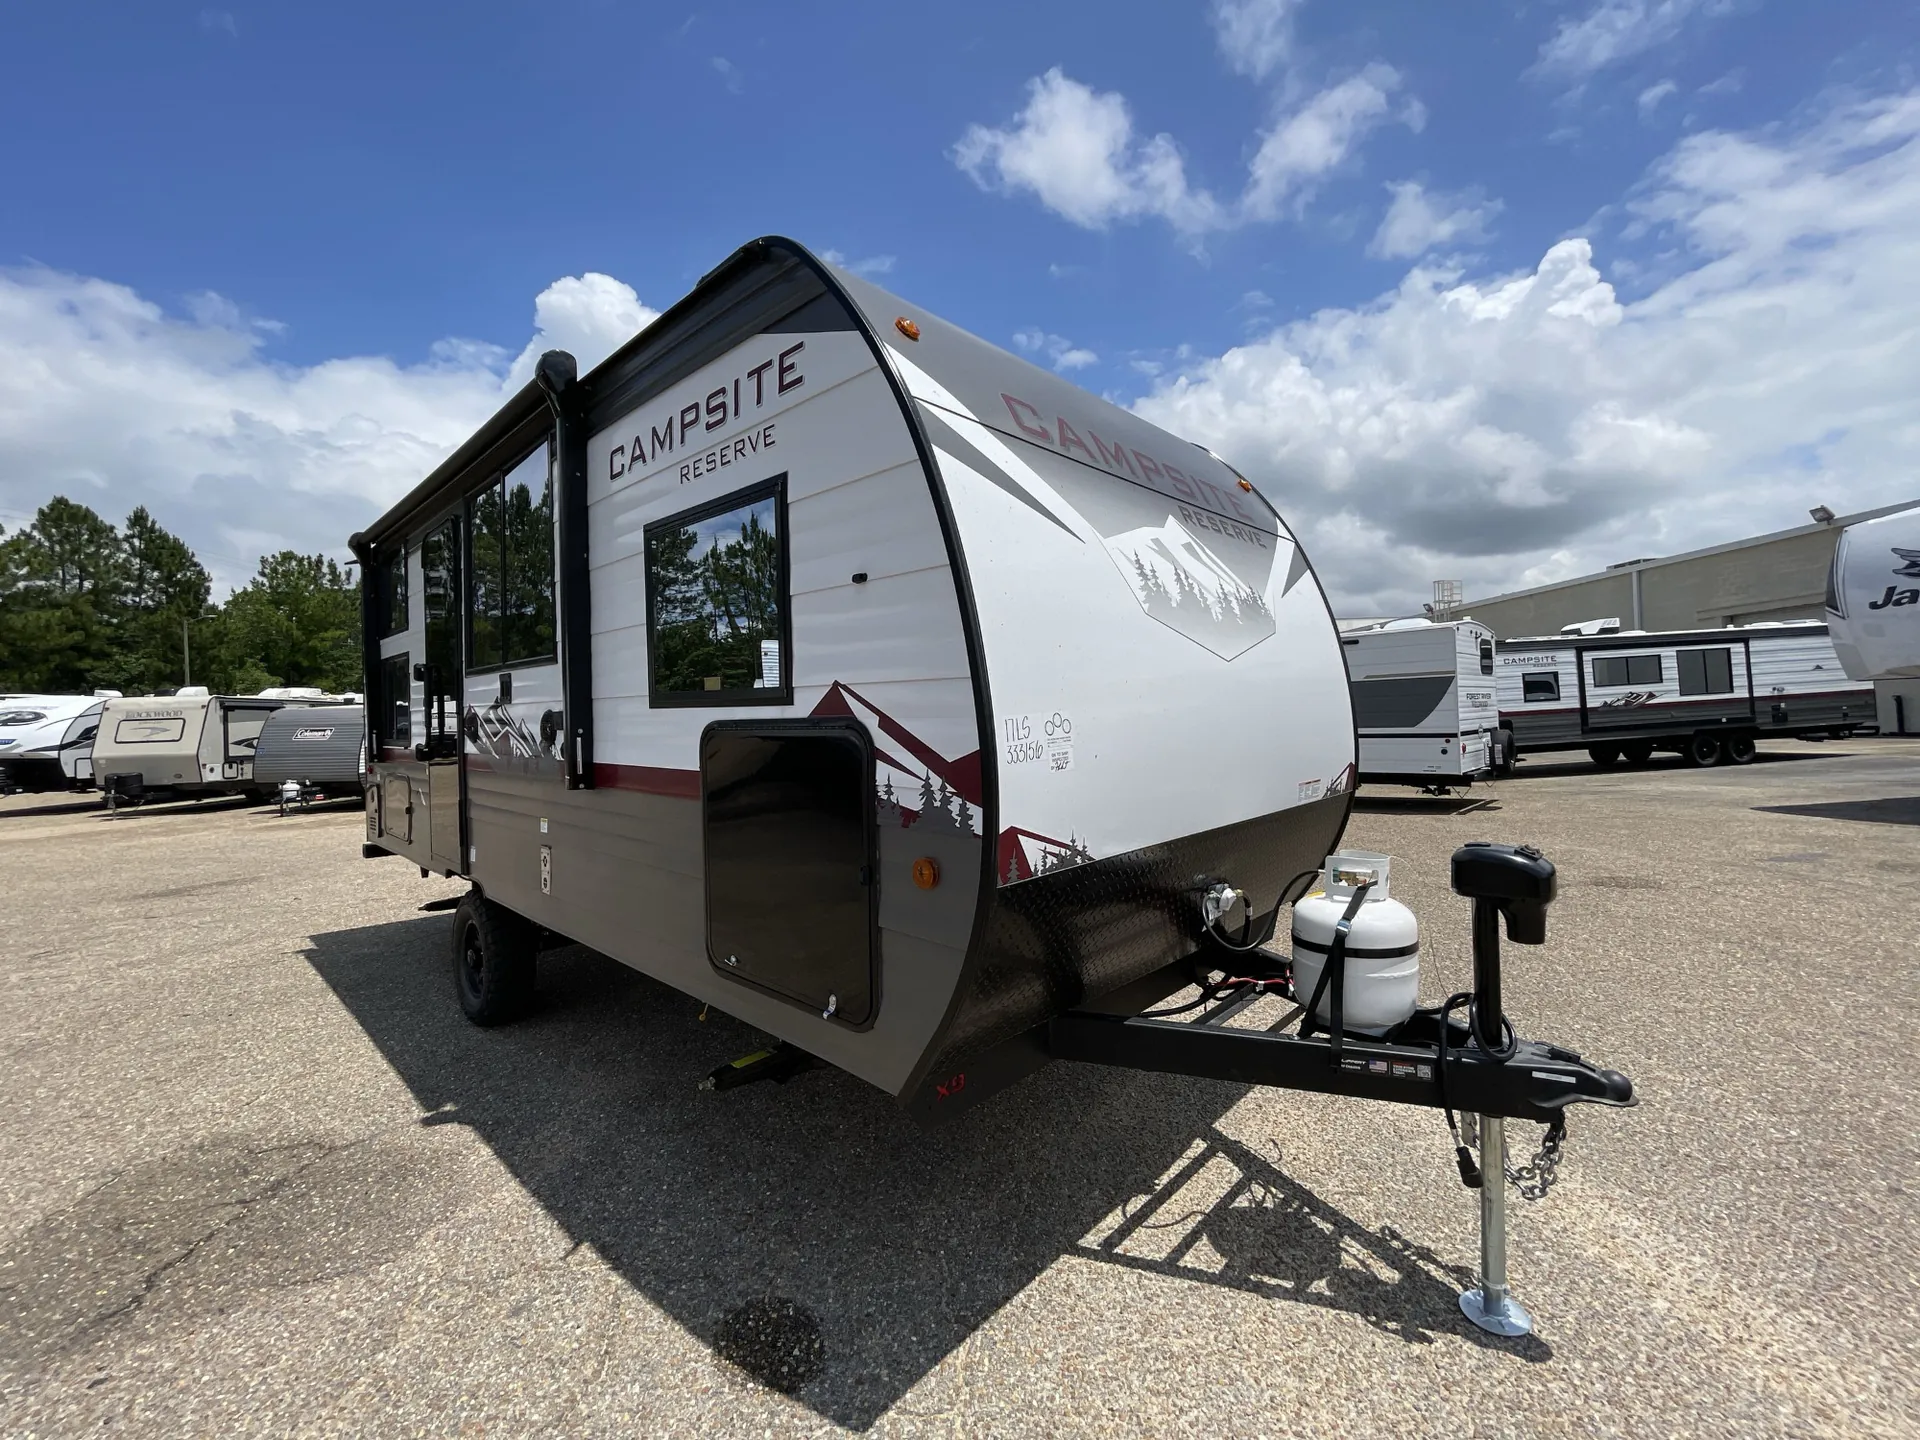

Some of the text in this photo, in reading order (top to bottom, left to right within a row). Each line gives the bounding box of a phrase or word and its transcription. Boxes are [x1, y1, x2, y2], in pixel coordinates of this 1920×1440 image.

[609, 341, 804, 480] CAMPSITE
[680, 423, 776, 485] RESERVE
[1000, 393, 1256, 523] CAMPSITE
[1178, 505, 1268, 550] RESERVE
[1868, 585, 1920, 610] Ja
[1503, 655, 1557, 665] CAMPSITE
[125, 709, 183, 719] ROCKWOOD
[297, 729, 325, 738] Coleman
[1006, 740, 1044, 765] 333156
